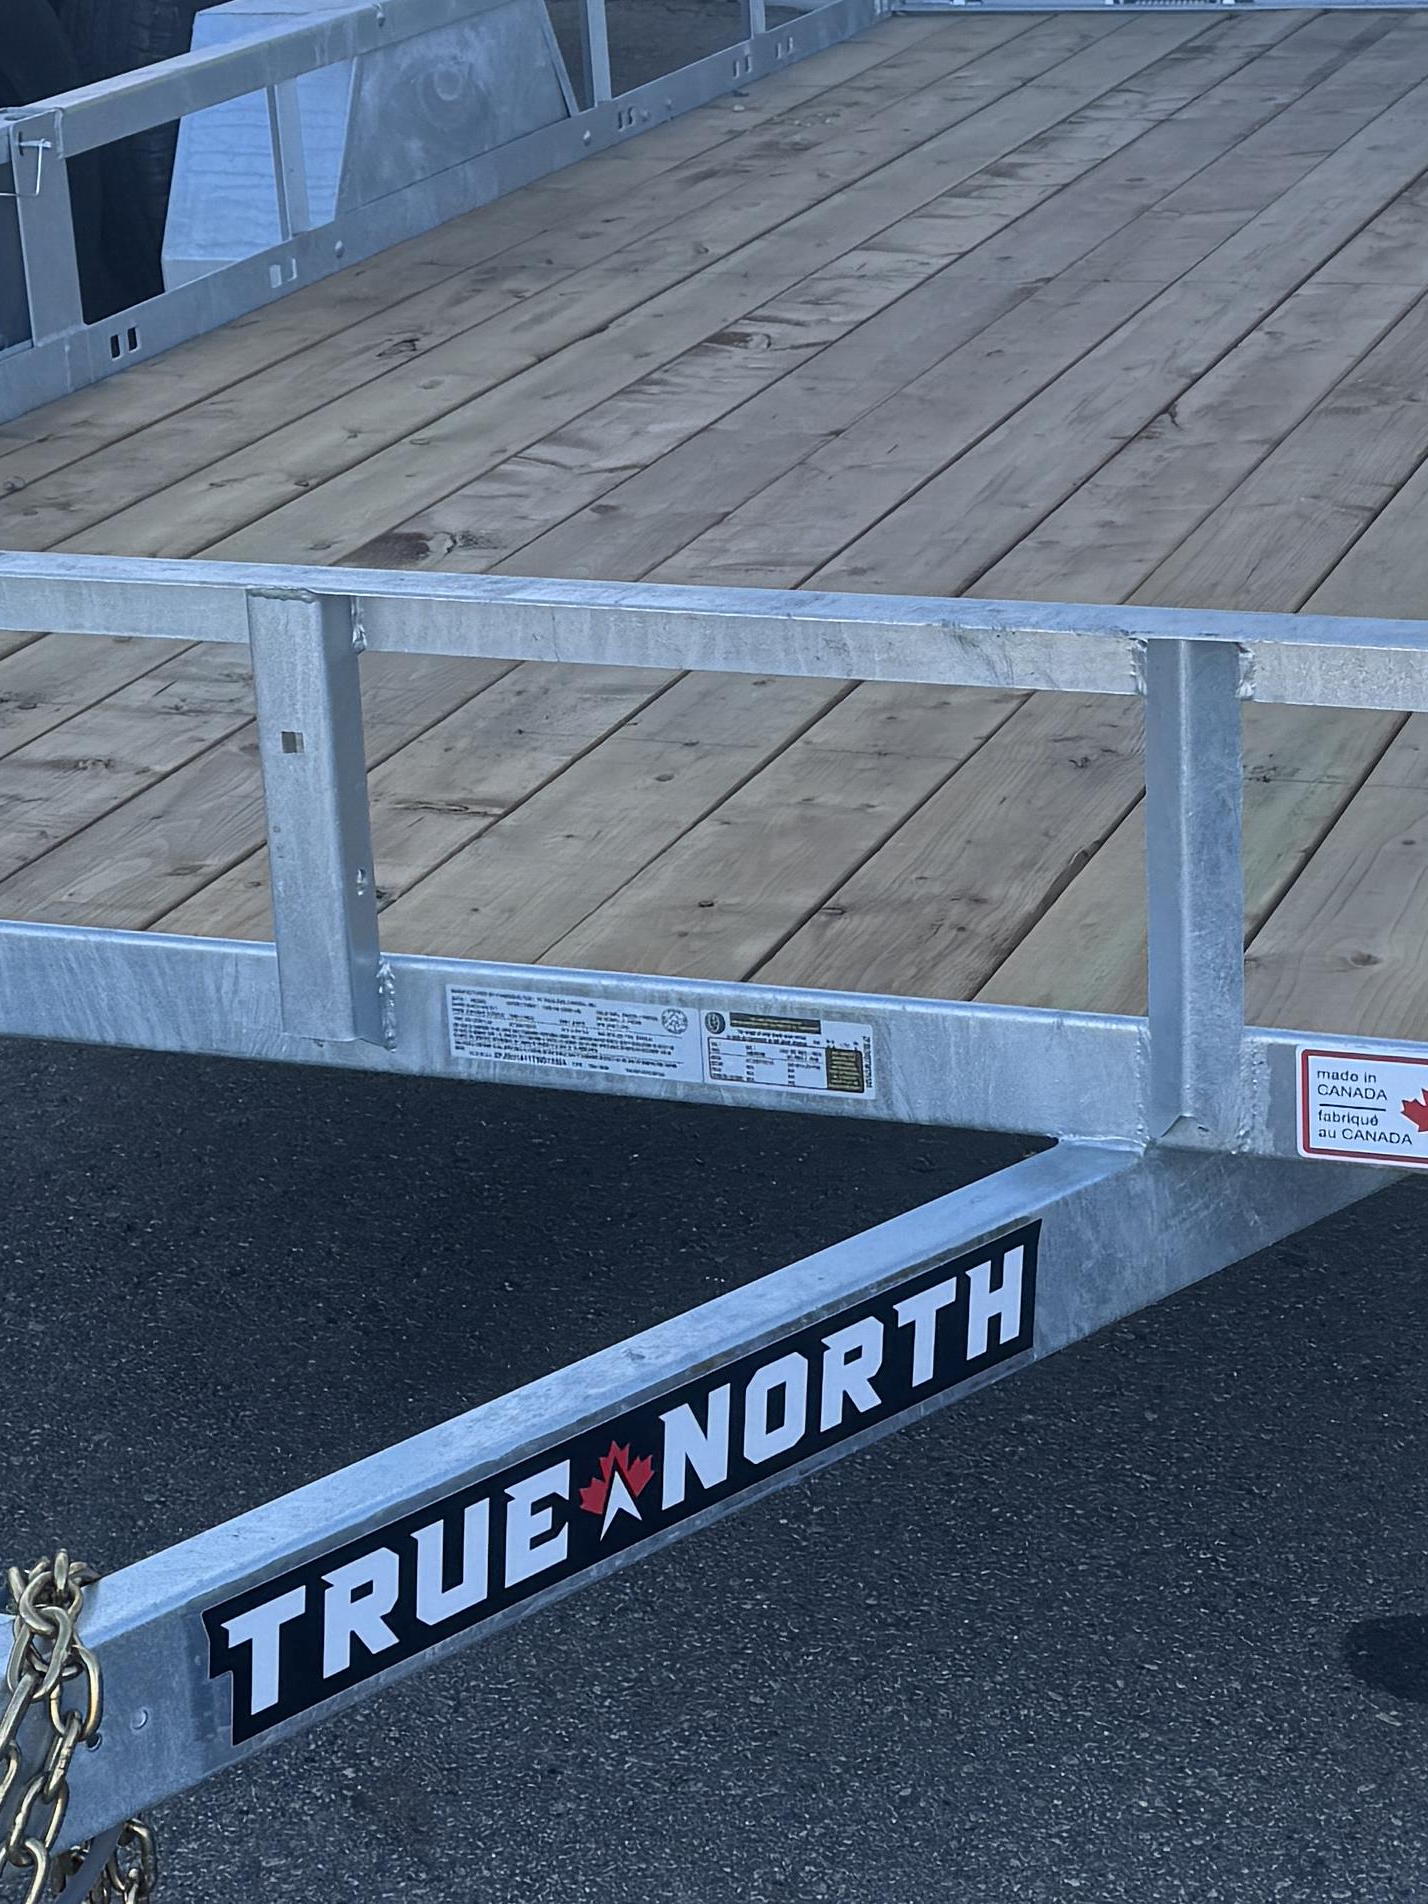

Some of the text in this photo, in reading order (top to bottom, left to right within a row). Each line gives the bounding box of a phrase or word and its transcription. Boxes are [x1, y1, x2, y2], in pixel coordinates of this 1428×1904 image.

[1317, 1070, 1376, 1083] made in
[1317, 1084, 1388, 1100] CANADA
[1318, 1128, 1413, 1145] au CANADA
[218, 1243, 1026, 1716] TRUE NORTH
